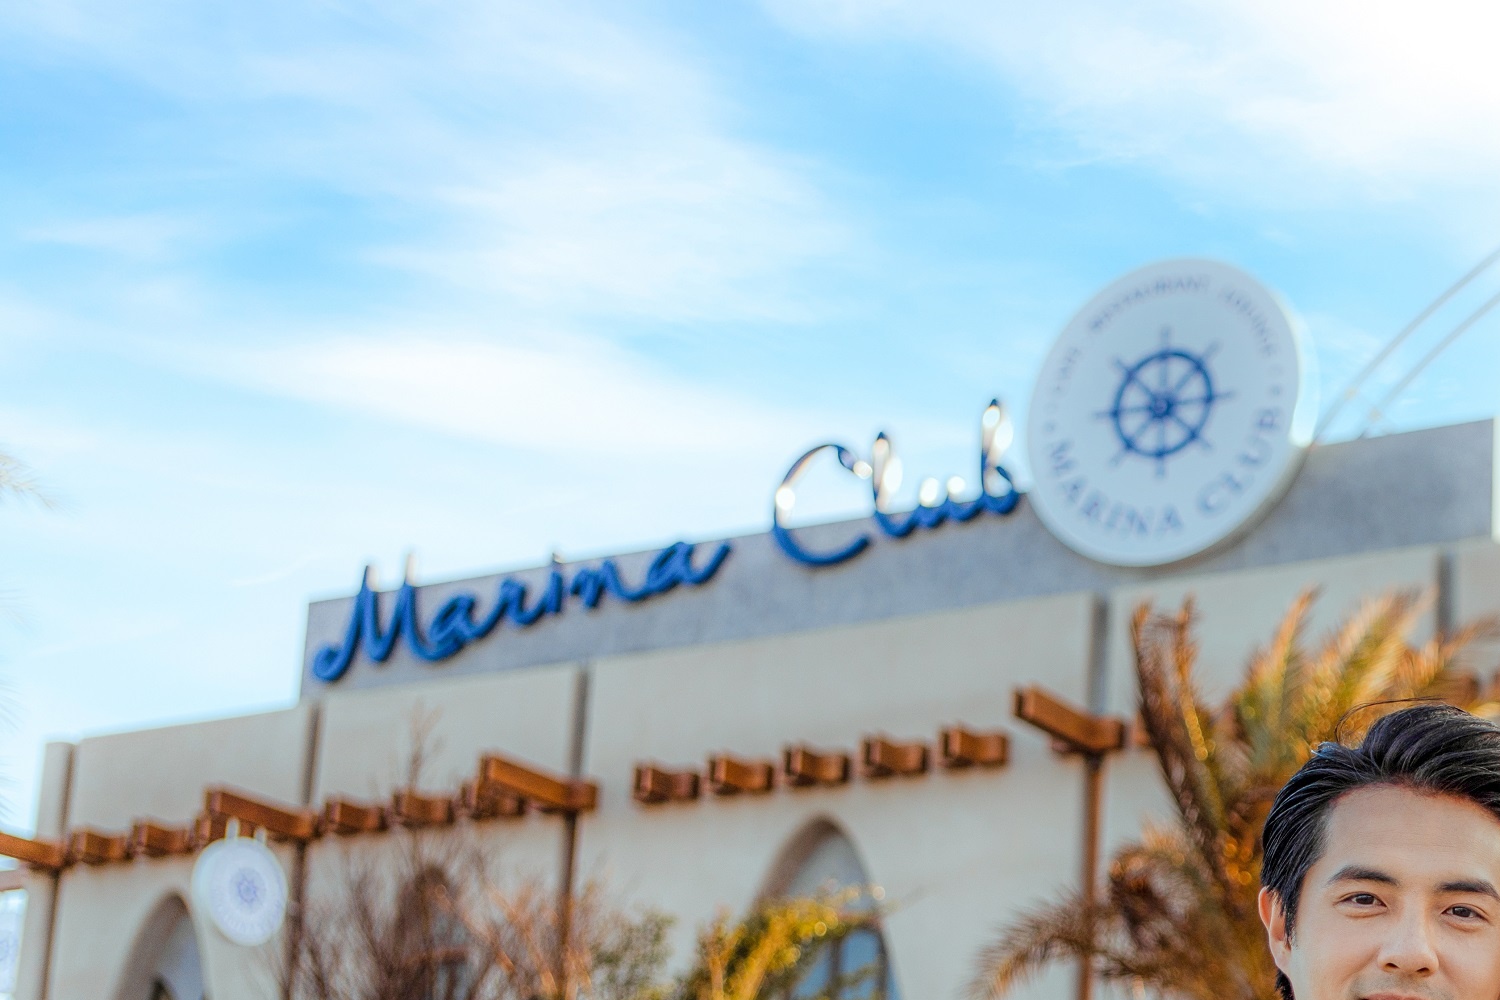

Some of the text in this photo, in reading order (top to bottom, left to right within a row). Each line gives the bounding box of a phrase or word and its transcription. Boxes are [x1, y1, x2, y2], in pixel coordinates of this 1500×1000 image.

[312, 397, 1026, 684] Marina Club
[1047, 407, 1282, 538] MARINA CLUB
